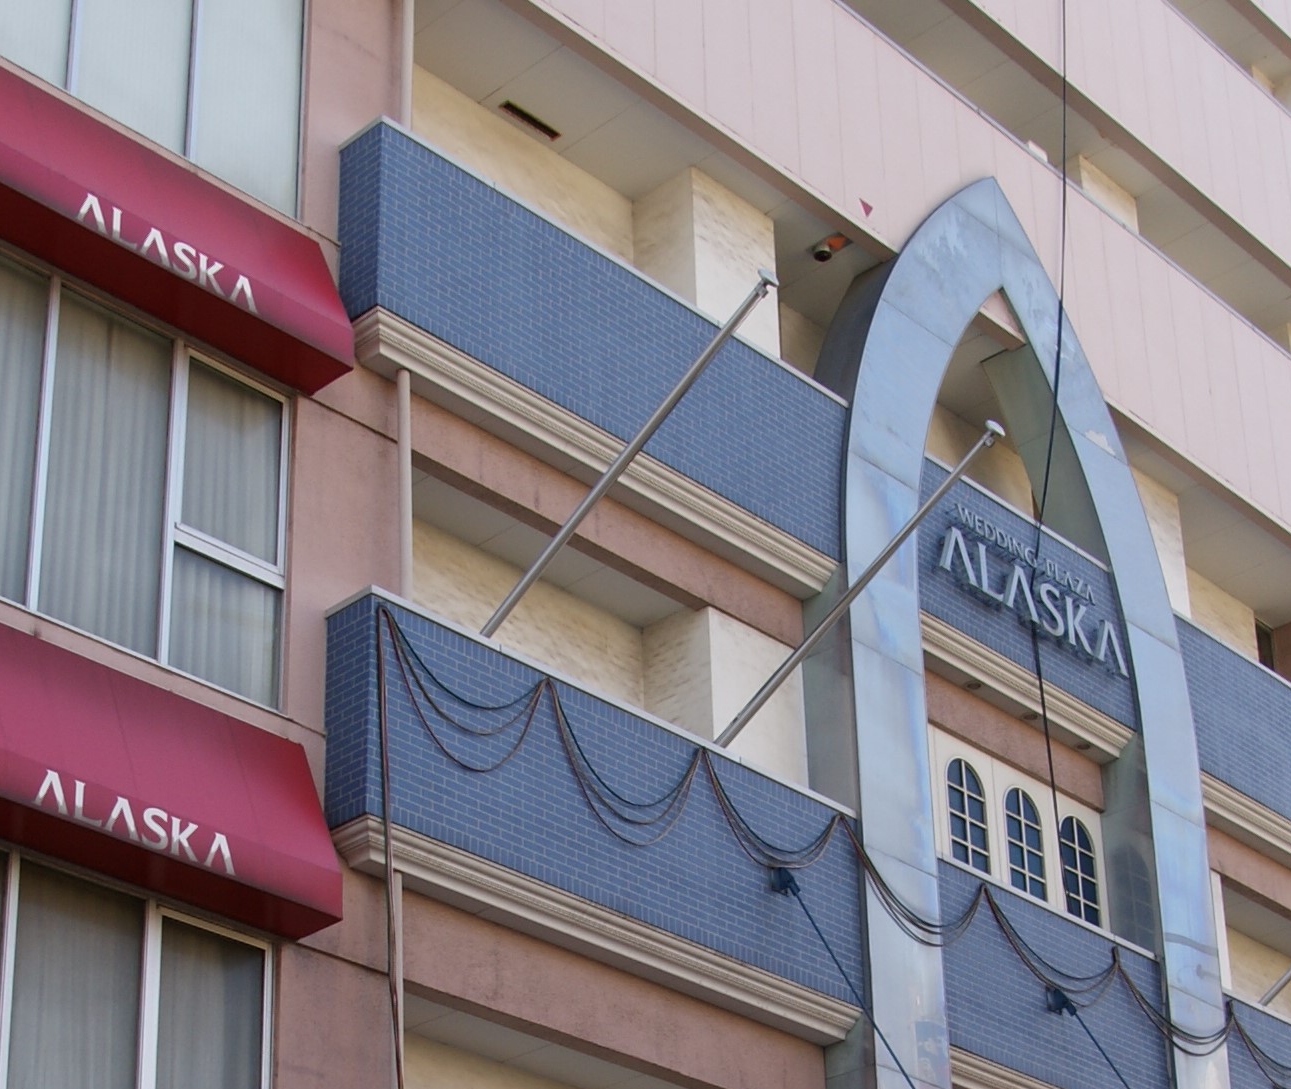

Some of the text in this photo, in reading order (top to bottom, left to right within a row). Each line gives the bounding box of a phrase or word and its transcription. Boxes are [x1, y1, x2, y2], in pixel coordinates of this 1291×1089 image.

[77, 192, 257, 314] ALASKA
[939, 526, 1130, 679] ALASKA
[961, 507, 1096, 605] WEDDING PLAZA
[32, 768, 237, 877] ALASKA
